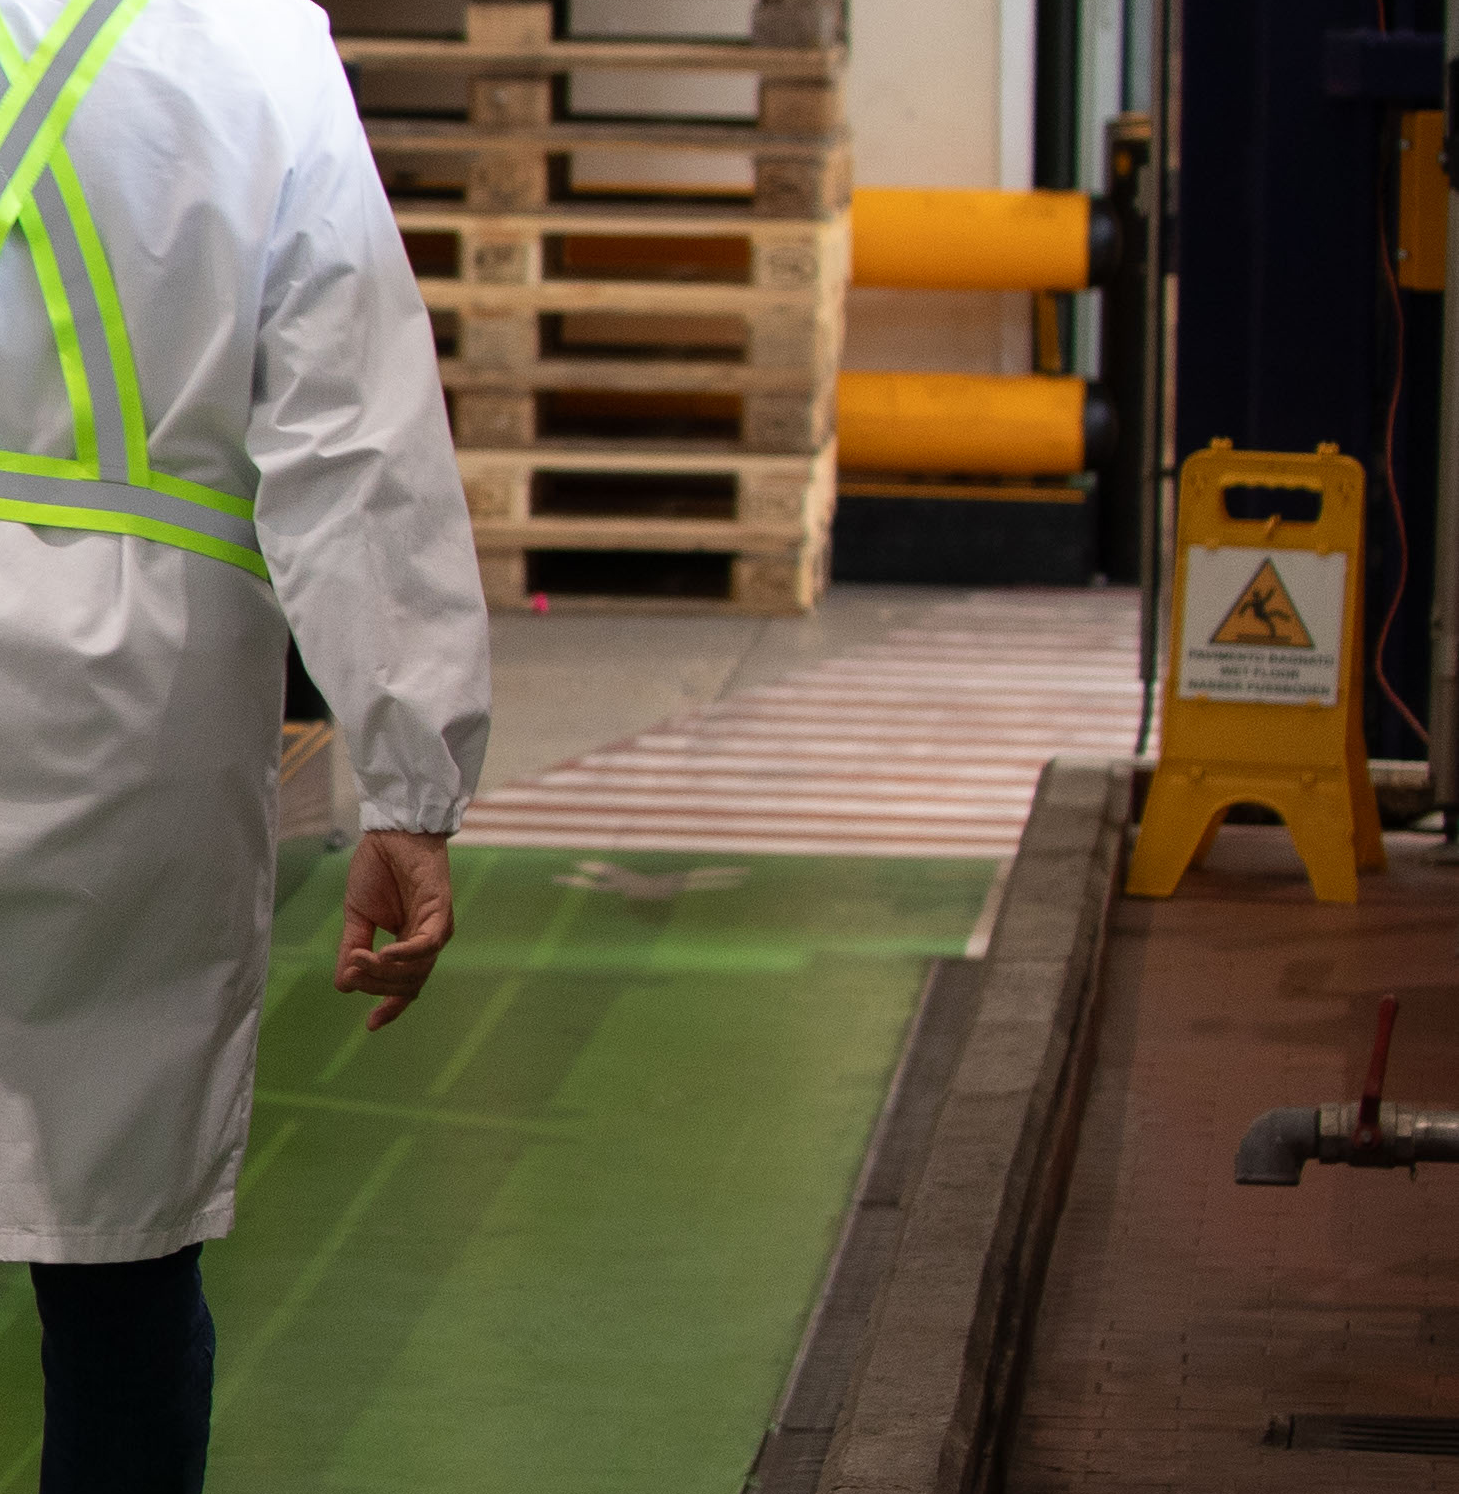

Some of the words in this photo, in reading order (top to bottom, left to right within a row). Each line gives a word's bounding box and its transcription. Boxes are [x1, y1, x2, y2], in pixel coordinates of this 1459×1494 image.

[1188, 649, 1265, 661] PAVIMENTO
[1268, 653, 1335, 667] BAGNATO
[1220, 665, 1248, 676] WET
[1253, 667, 1300, 680] FLOOR
